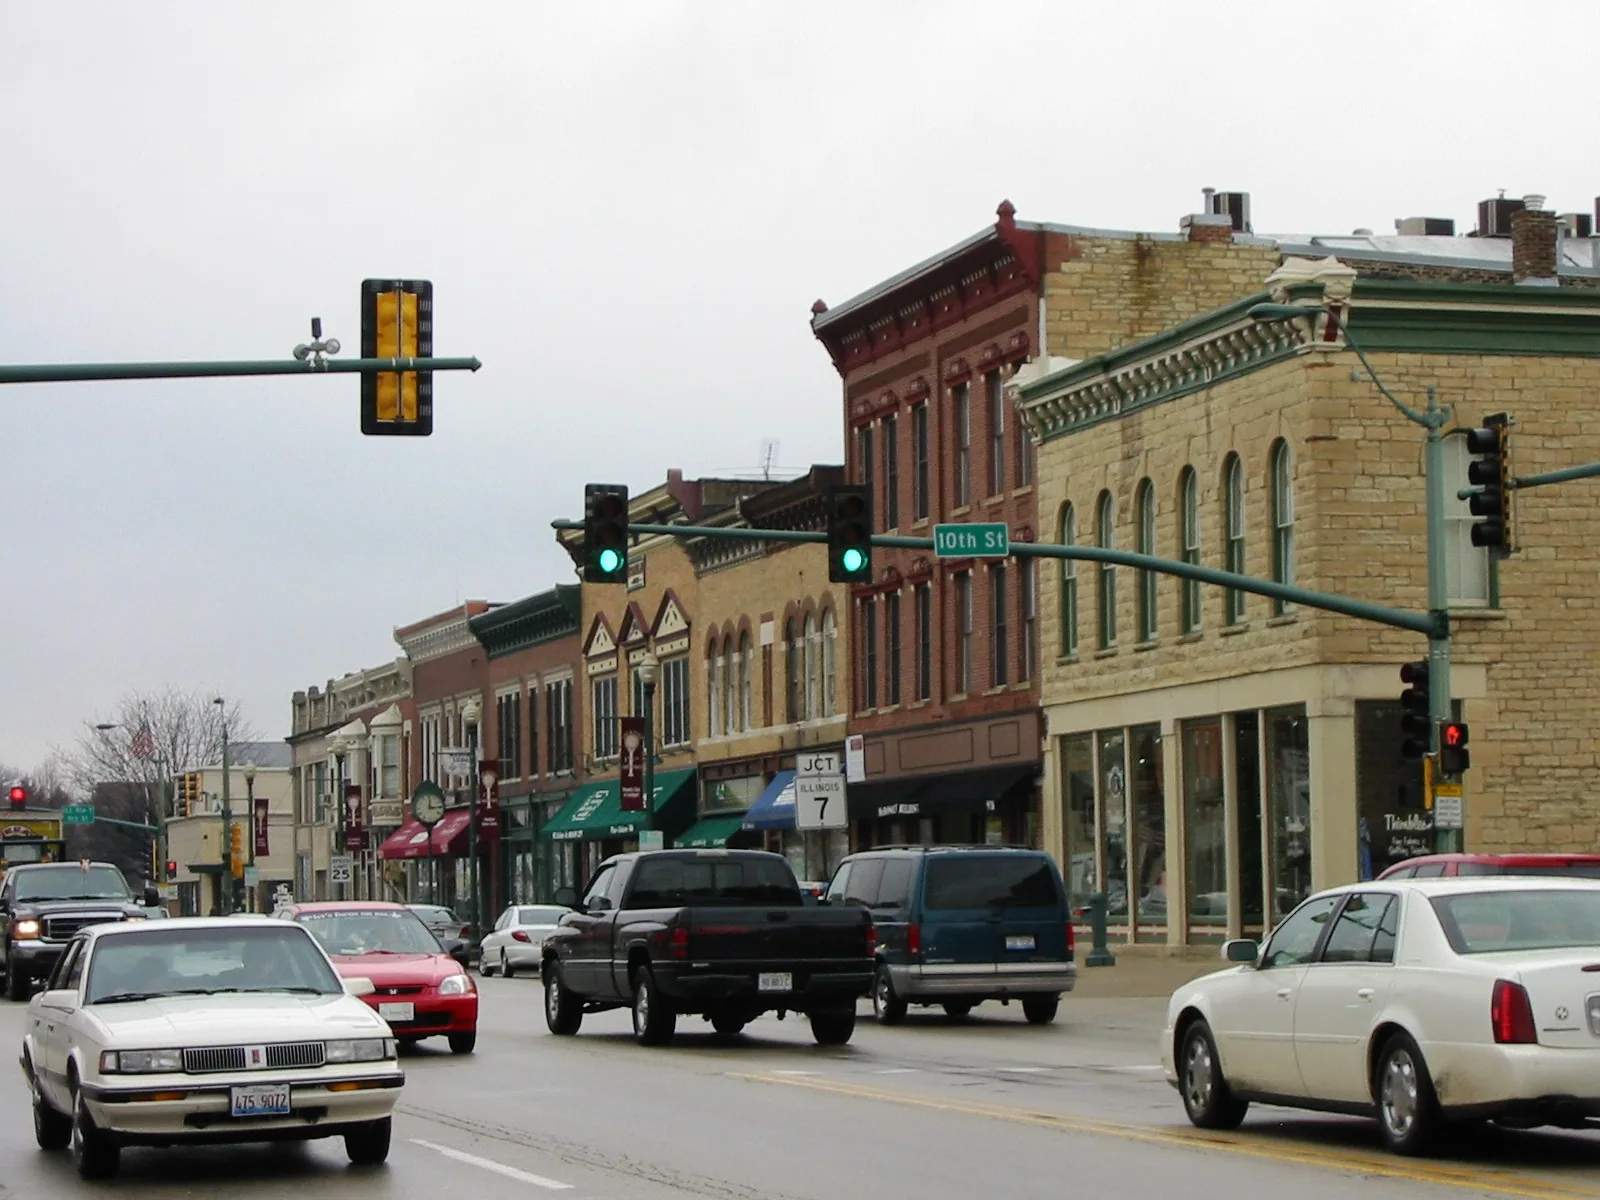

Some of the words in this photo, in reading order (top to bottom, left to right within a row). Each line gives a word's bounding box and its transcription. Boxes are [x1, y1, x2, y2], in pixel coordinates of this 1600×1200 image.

[939, 532, 977, 549] 10th
[984, 531, 1004, 548] St
[804, 757, 834, 772] JCT
[800, 783, 840, 793] ILLINOIS
[813, 796, 829, 820] 7
[333, 869, 350, 880] 25
[236, 1095, 254, 1109] 475
[261, 1094, 286, 1107] 9072
